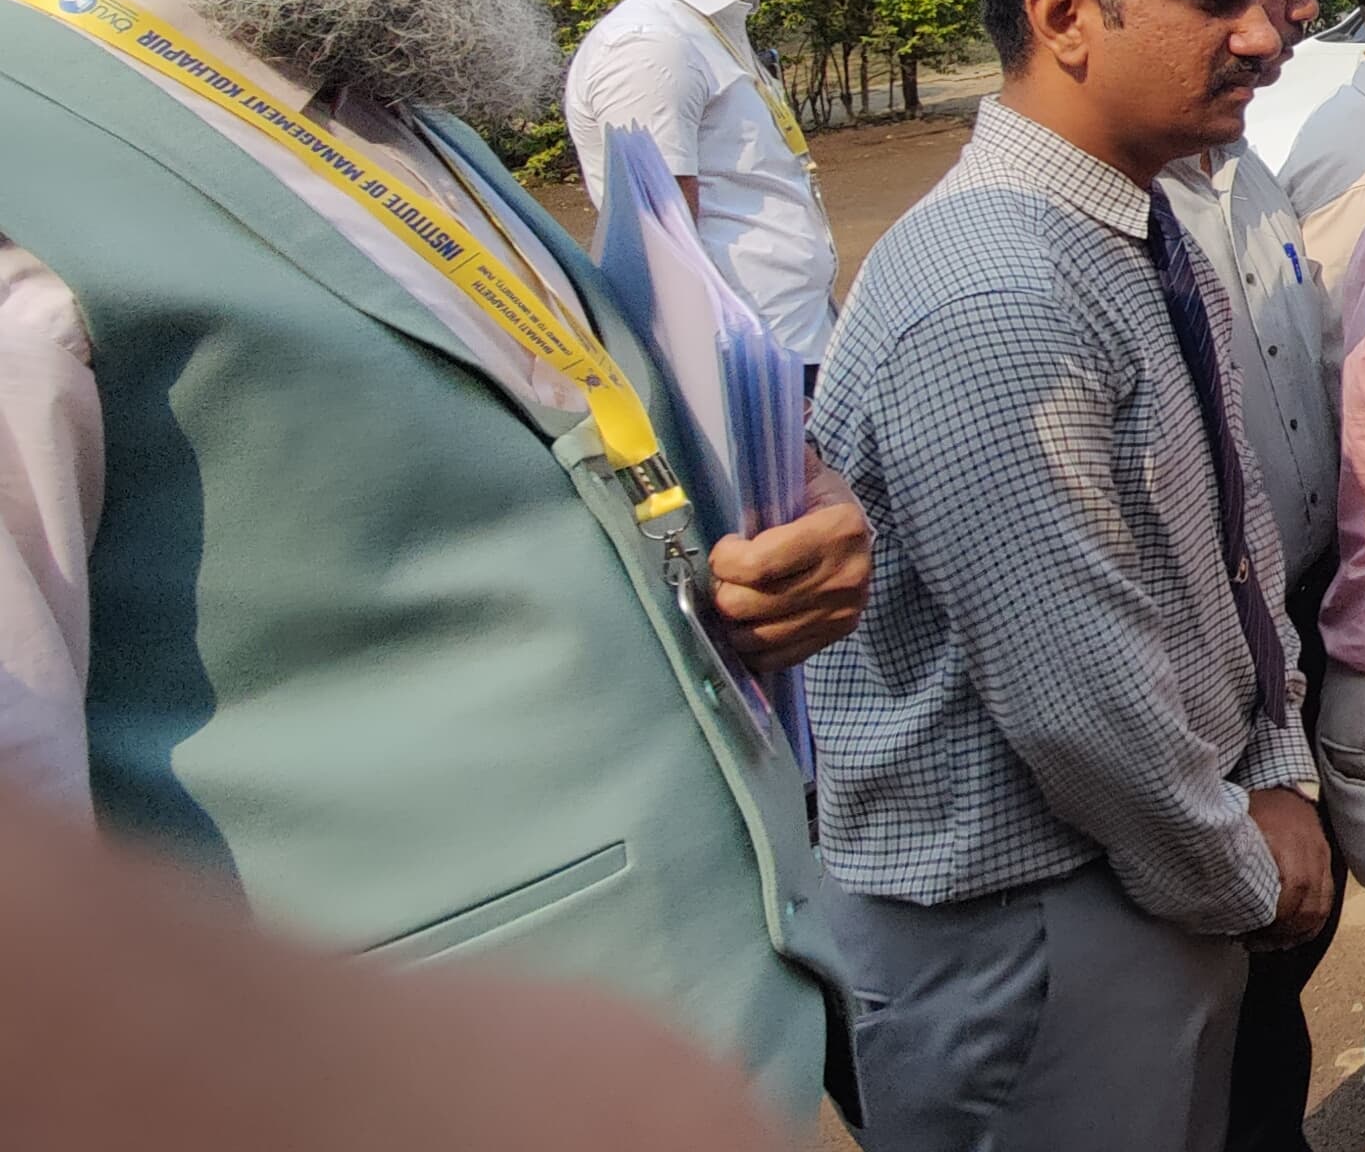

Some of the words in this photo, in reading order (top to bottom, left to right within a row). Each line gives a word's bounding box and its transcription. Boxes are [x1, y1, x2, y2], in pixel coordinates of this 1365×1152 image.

[136, 29, 246, 98] KOLHAPUR
[238, 95, 366, 182] MANAGEMENT
[358, 178, 389, 199] OF
[382, 193, 464, 261] INSTITUTE
[471, 279, 520, 325] VIDYAPEETH
[518, 320, 554, 355] BHARATI
